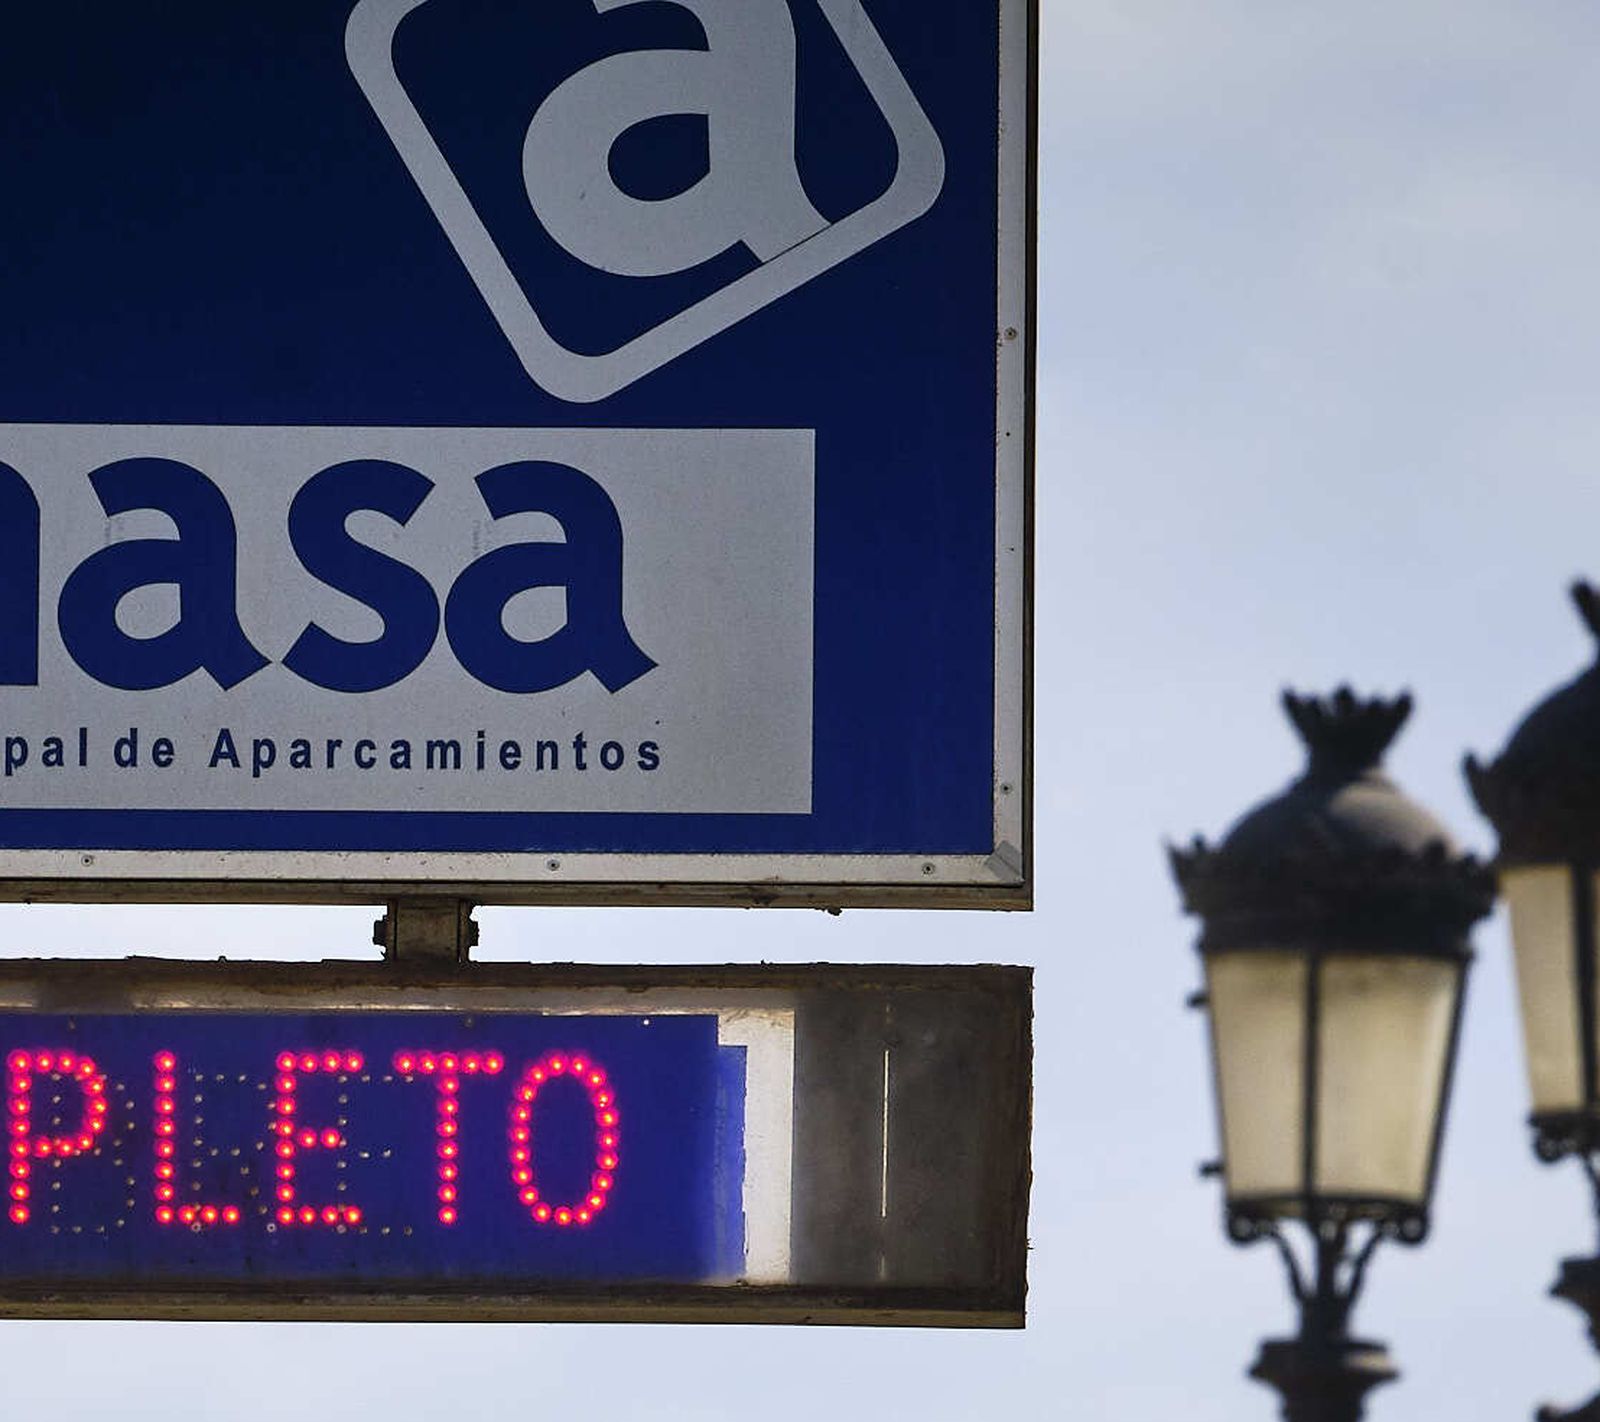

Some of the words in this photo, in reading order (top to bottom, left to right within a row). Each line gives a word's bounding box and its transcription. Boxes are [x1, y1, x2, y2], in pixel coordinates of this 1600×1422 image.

[0, 456, 659, 694] asa
[4, 727, 88, 777] pal
[113, 727, 175, 768] de
[208, 727, 661, 779] Aparcamientos
[8, 1049, 621, 1226] PLETO
